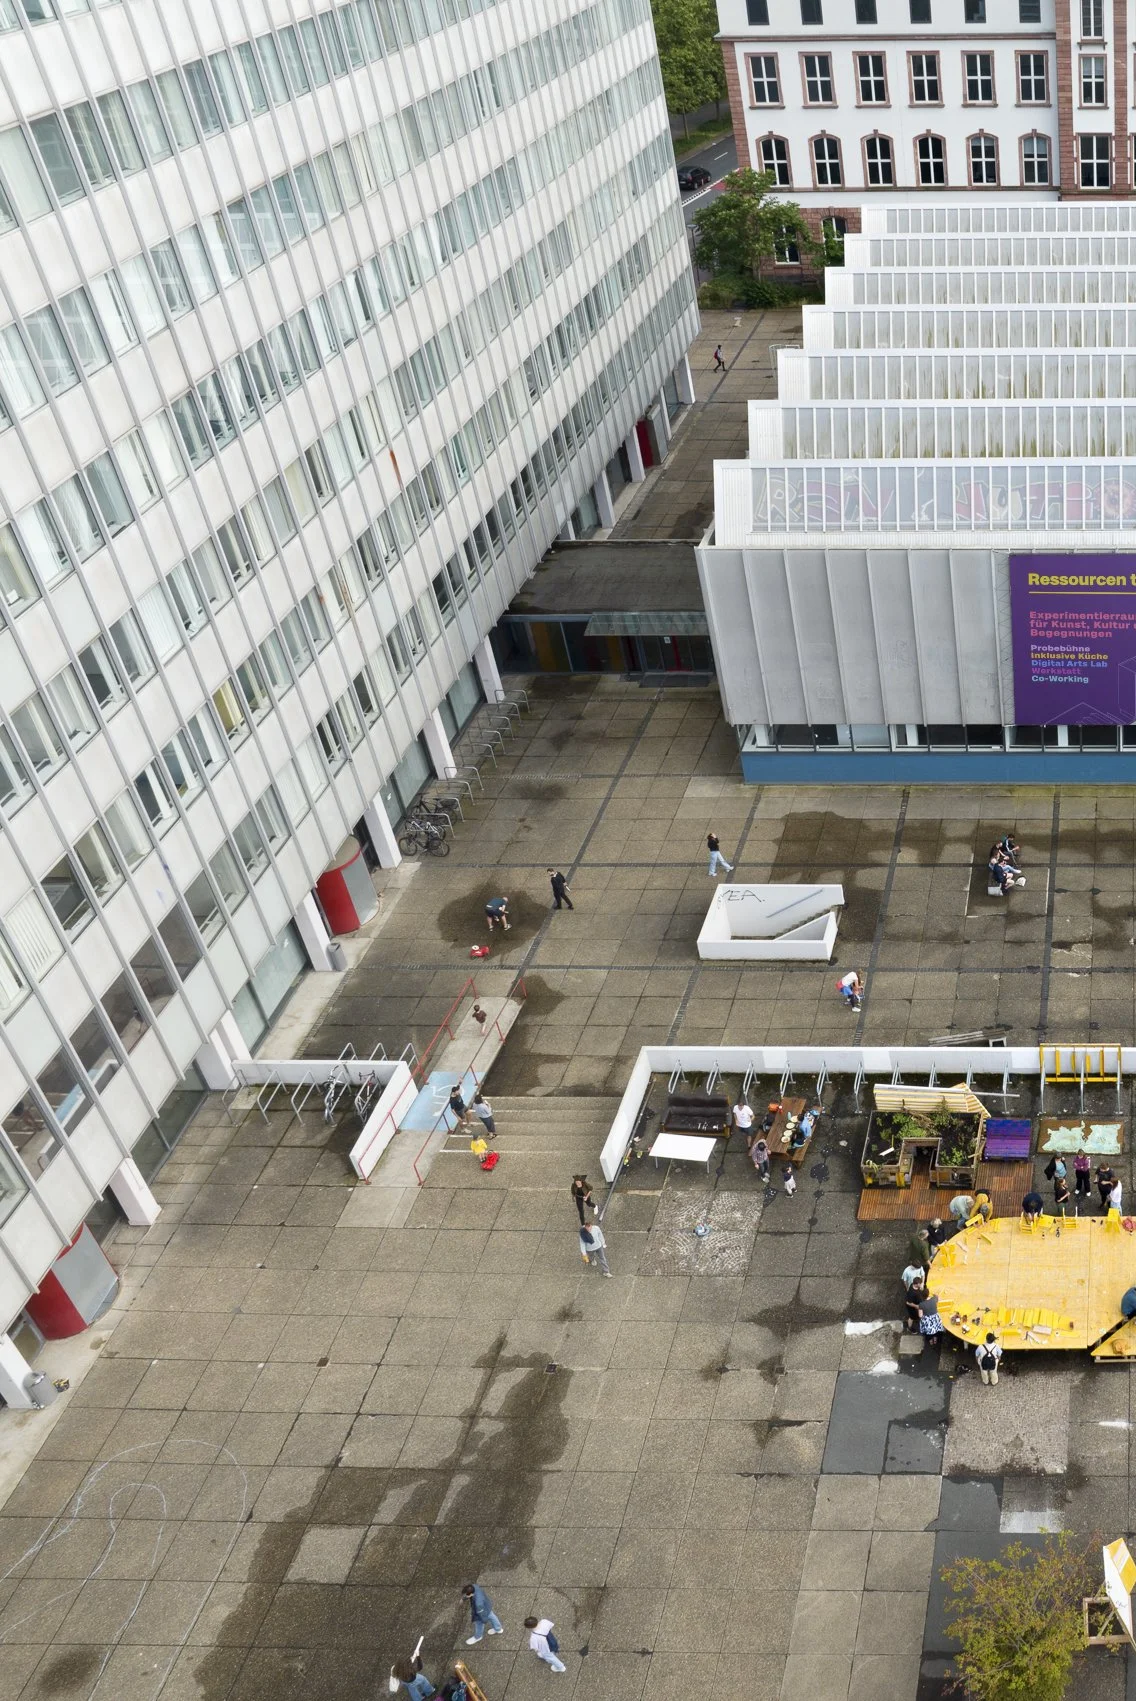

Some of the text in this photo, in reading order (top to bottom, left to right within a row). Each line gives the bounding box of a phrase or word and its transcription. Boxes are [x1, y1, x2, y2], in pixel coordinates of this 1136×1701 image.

[1028, 573, 1127, 587] Ressourcen
[1029, 619, 1048, 628] für
[1051, 620, 1090, 629] Kunst,
[1093, 621, 1131, 630] Kultur
[1030, 628, 1113, 639] Begegnungen
[1030, 644, 1091, 652] Probebühne
[1030, 652, 1109, 660] Inklusive Küche
[1031, 659, 1108, 668] Digital Arts Lab
[1031, 667, 1082, 675] Werkstatt
[1031, 675, 1089, 684] Co-Working
